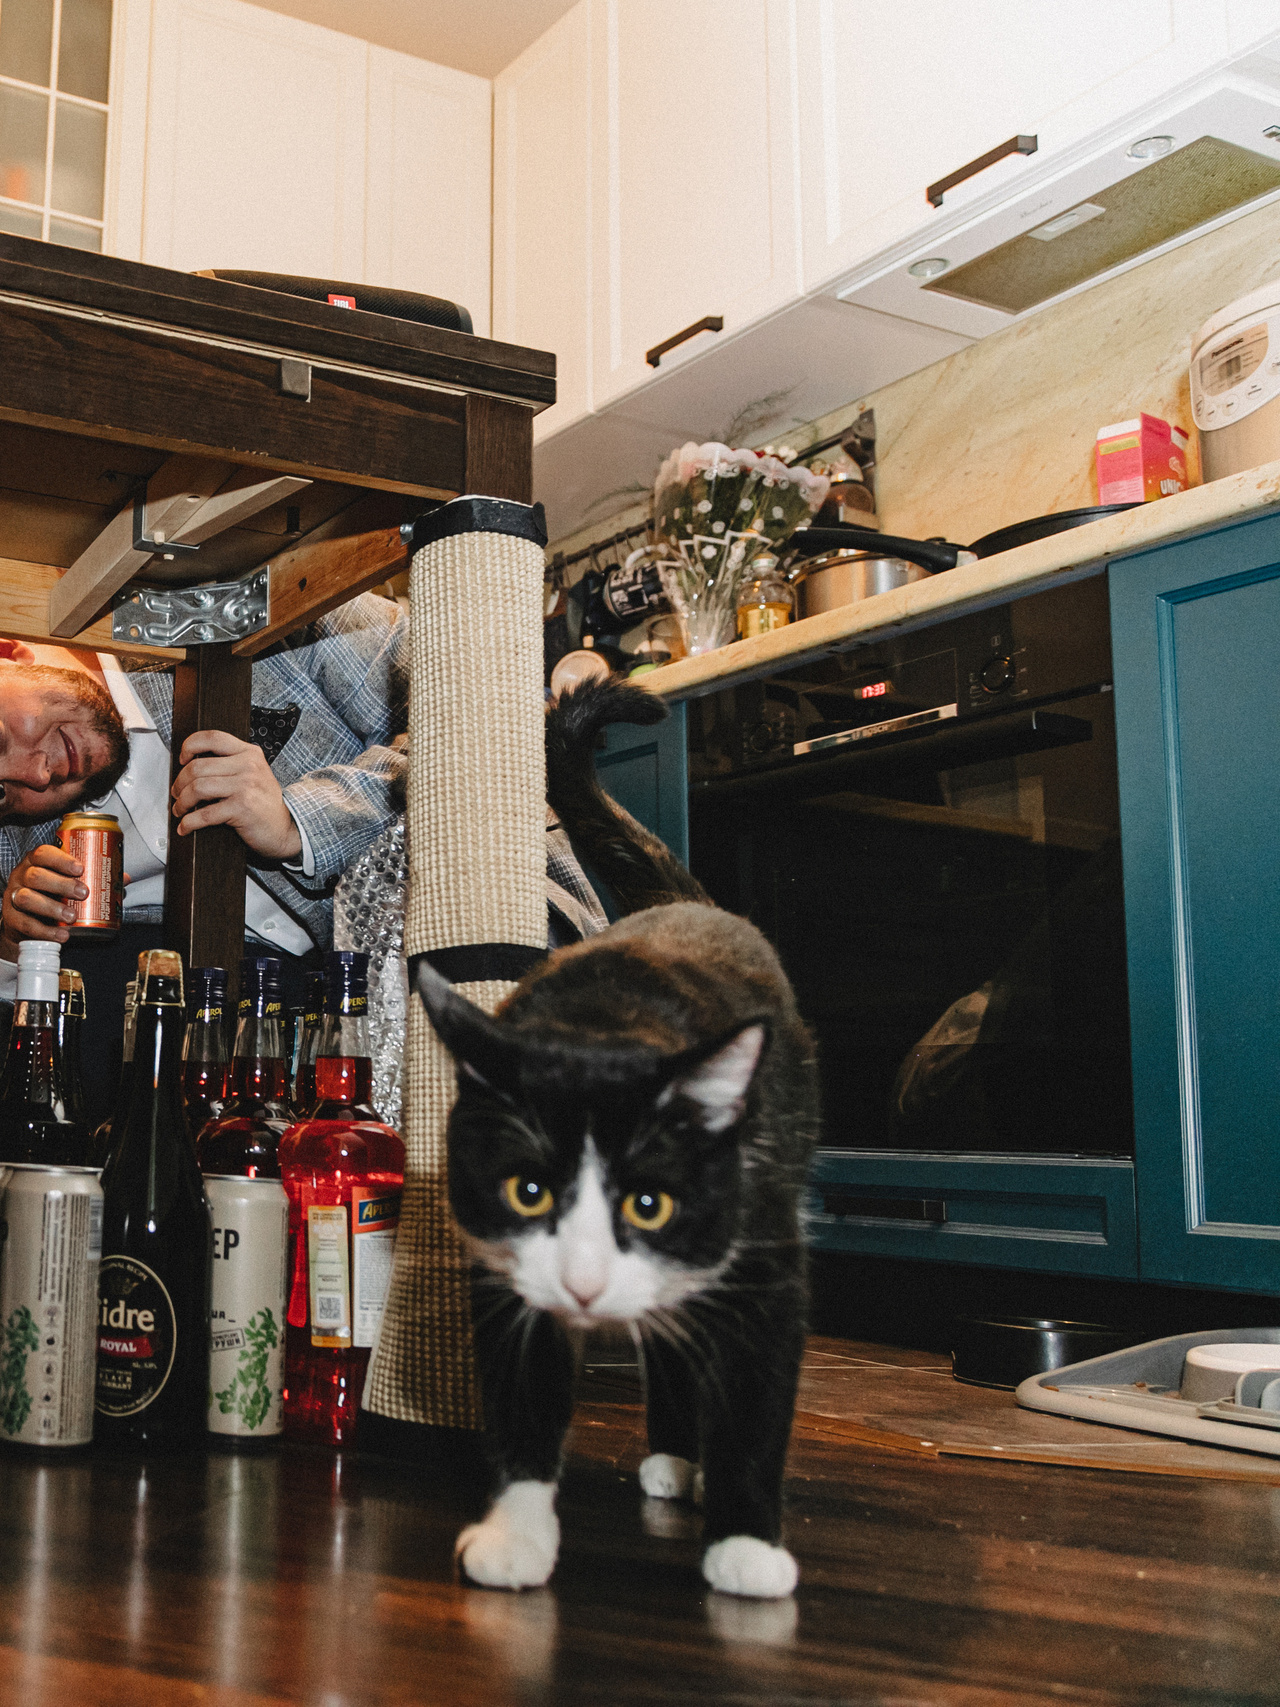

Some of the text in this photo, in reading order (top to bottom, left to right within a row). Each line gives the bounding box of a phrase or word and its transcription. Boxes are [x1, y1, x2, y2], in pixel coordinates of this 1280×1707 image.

[862, 682, 886, 699] 17:33
[98, 1298, 155, 1332] idre
[100, 1338, 137, 1353] ROYAL
